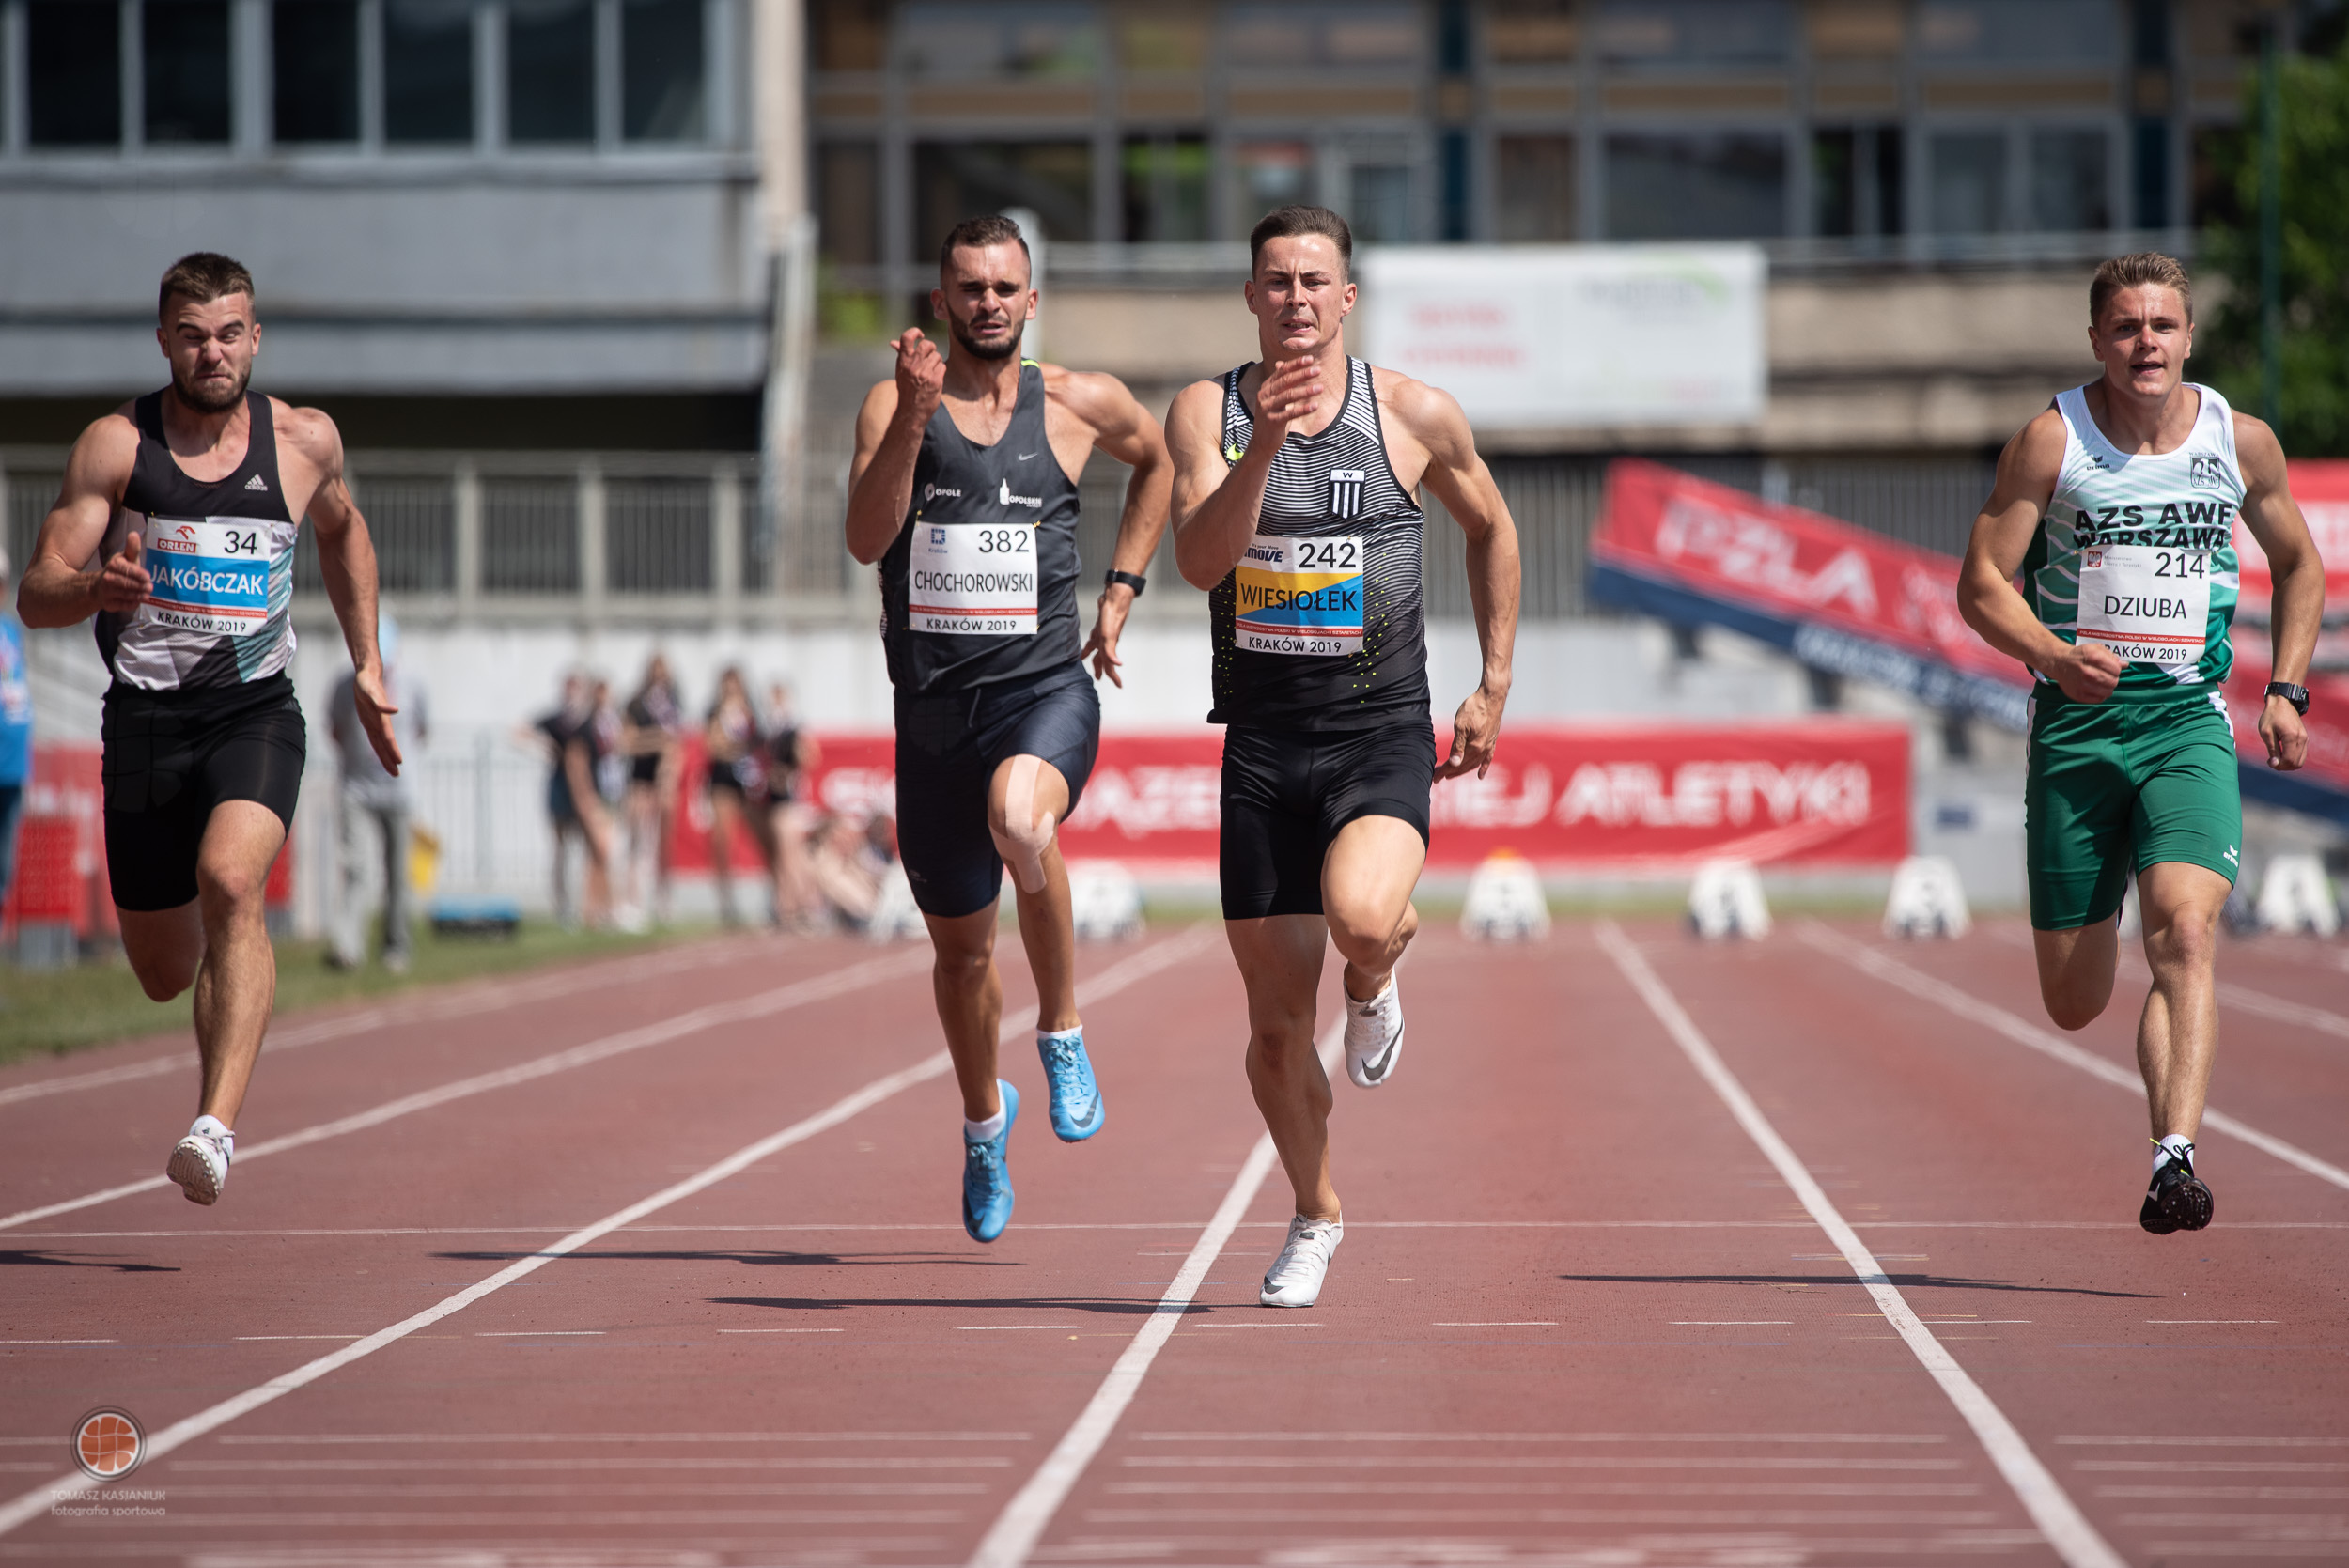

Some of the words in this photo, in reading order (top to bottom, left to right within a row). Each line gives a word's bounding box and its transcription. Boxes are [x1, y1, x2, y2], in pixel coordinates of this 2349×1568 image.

[2075, 505, 2144, 531] AZS
[2158, 502, 2232, 525] AWF
[159, 540, 195, 552] ORLEN
[224, 530, 257, 555] 34
[978, 529, 1030, 553] 382
[2073, 527, 2226, 549] WARSZAWA
[1245, 547, 1284, 563] MOVE
[1298, 542, 1357, 569] 242
[1654, 495, 1878, 622] PZLA
[2155, 551, 2205, 579] 214
[150, 564, 264, 596] JAKÓBCZAK
[914, 570, 1033, 593] CHOCHOROWSKI
[1240, 582, 1357, 612] WIESIOŁEK
[2104, 594, 2187, 619] DZIUBA
[157, 611, 214, 629] KRAKÓW
[217, 620, 246, 632] 2019
[926, 617, 983, 631] KRAKÓW
[987, 620, 1017, 631] 2019
[1249, 636, 1305, 653] KRAKÓW
[1309, 641, 1342, 653] 2019
[2105, 644, 2155, 659] AKÓW
[2158, 648, 2187, 660] 2019
[1555, 759, 1871, 827] ATLETYKI
